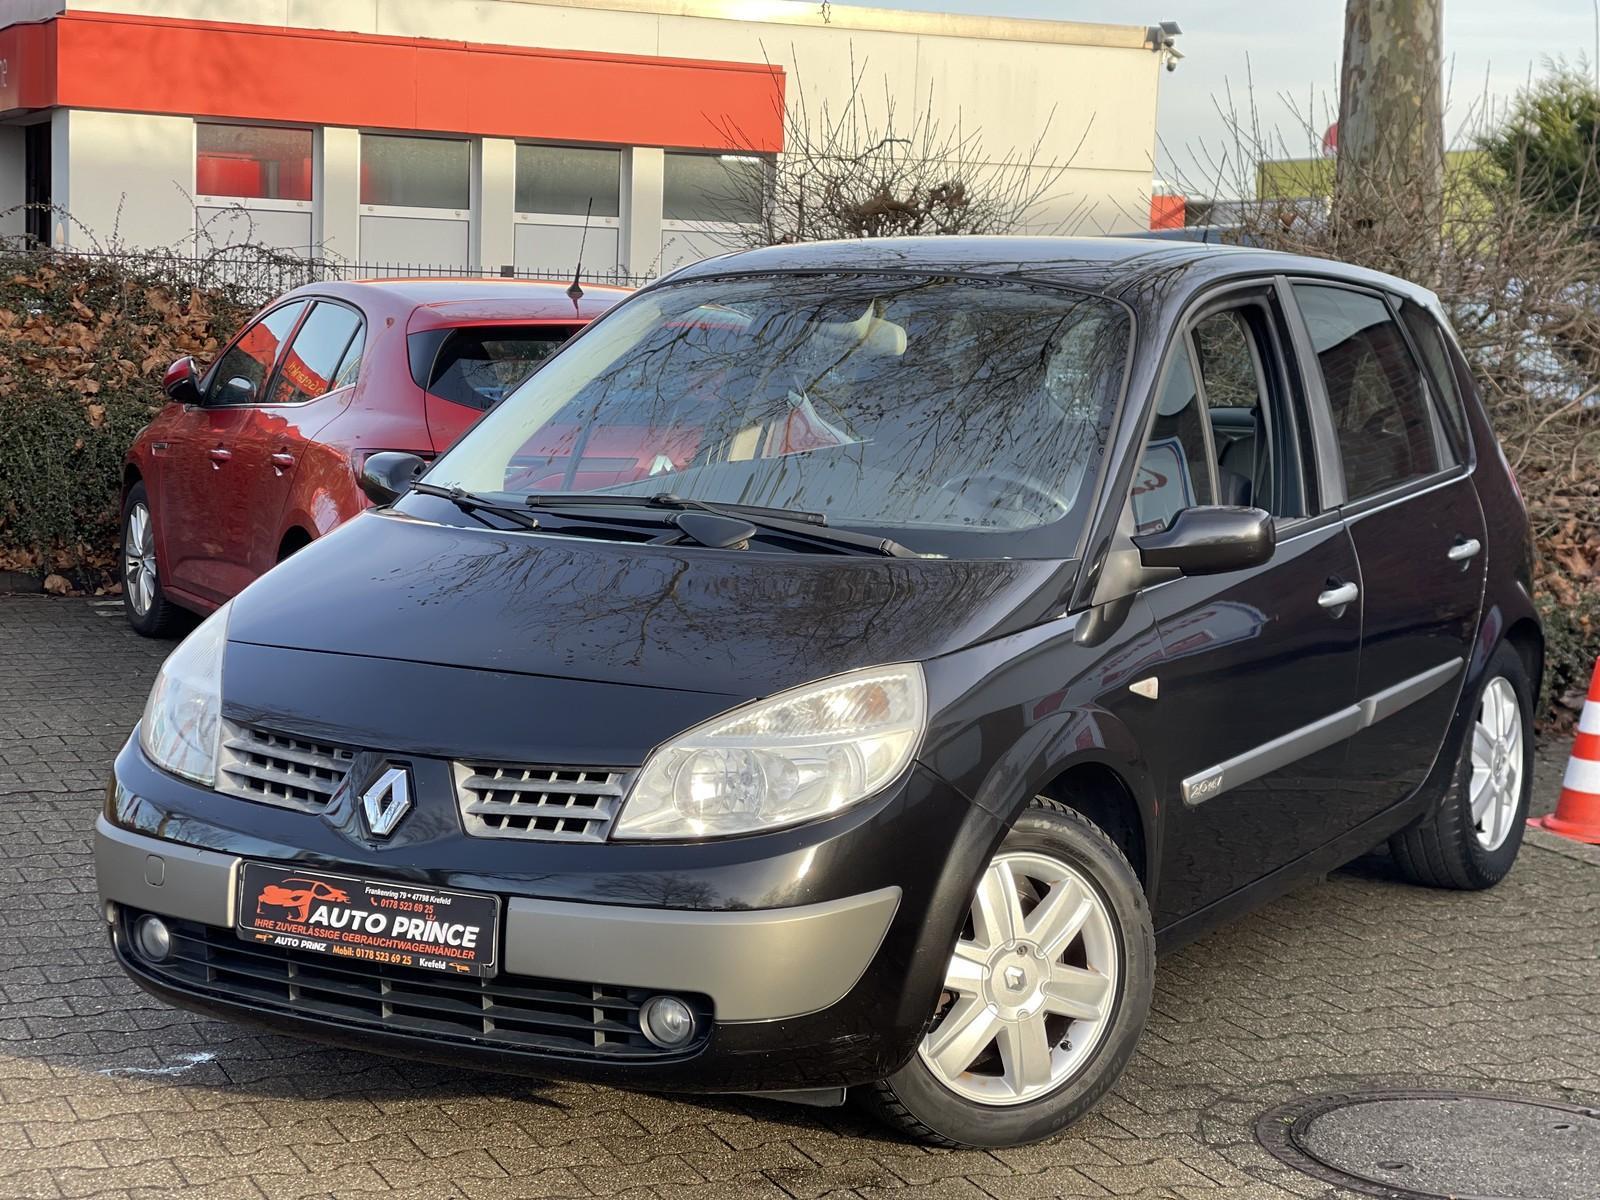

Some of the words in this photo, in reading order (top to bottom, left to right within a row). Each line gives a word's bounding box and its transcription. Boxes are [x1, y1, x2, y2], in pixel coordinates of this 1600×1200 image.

[365, 886, 399, 899] Frankenring
[399, 891, 407, 899] 79
[412, 893, 429, 902] 47798
[430, 896, 452, 905] Krefeld
[380, 898, 398, 909] 0178
[399, 901, 412, 911] 523
[413, 903, 423, 912] 69
[424, 905, 434, 914] 25
[254, 918, 275, 929] IHRE
[275, 921, 340, 939] ZUVERLÄSSIGE
[342, 933, 475, 959] GEBRAUCHTWAGENHÄNDLER
[309, 905, 387, 933] AUTO
[391, 916, 480, 948] PRINCE
[274, 936, 299, 948] AUTO
[332, 944, 354, 957] Mobil:
[355, 948, 374, 960] 0178
[375, 951, 390, 962] 523
[391, 954, 401, 963] 69
[402, 955, 412, 965] 25
[419, 957, 446, 970] Krefeld
